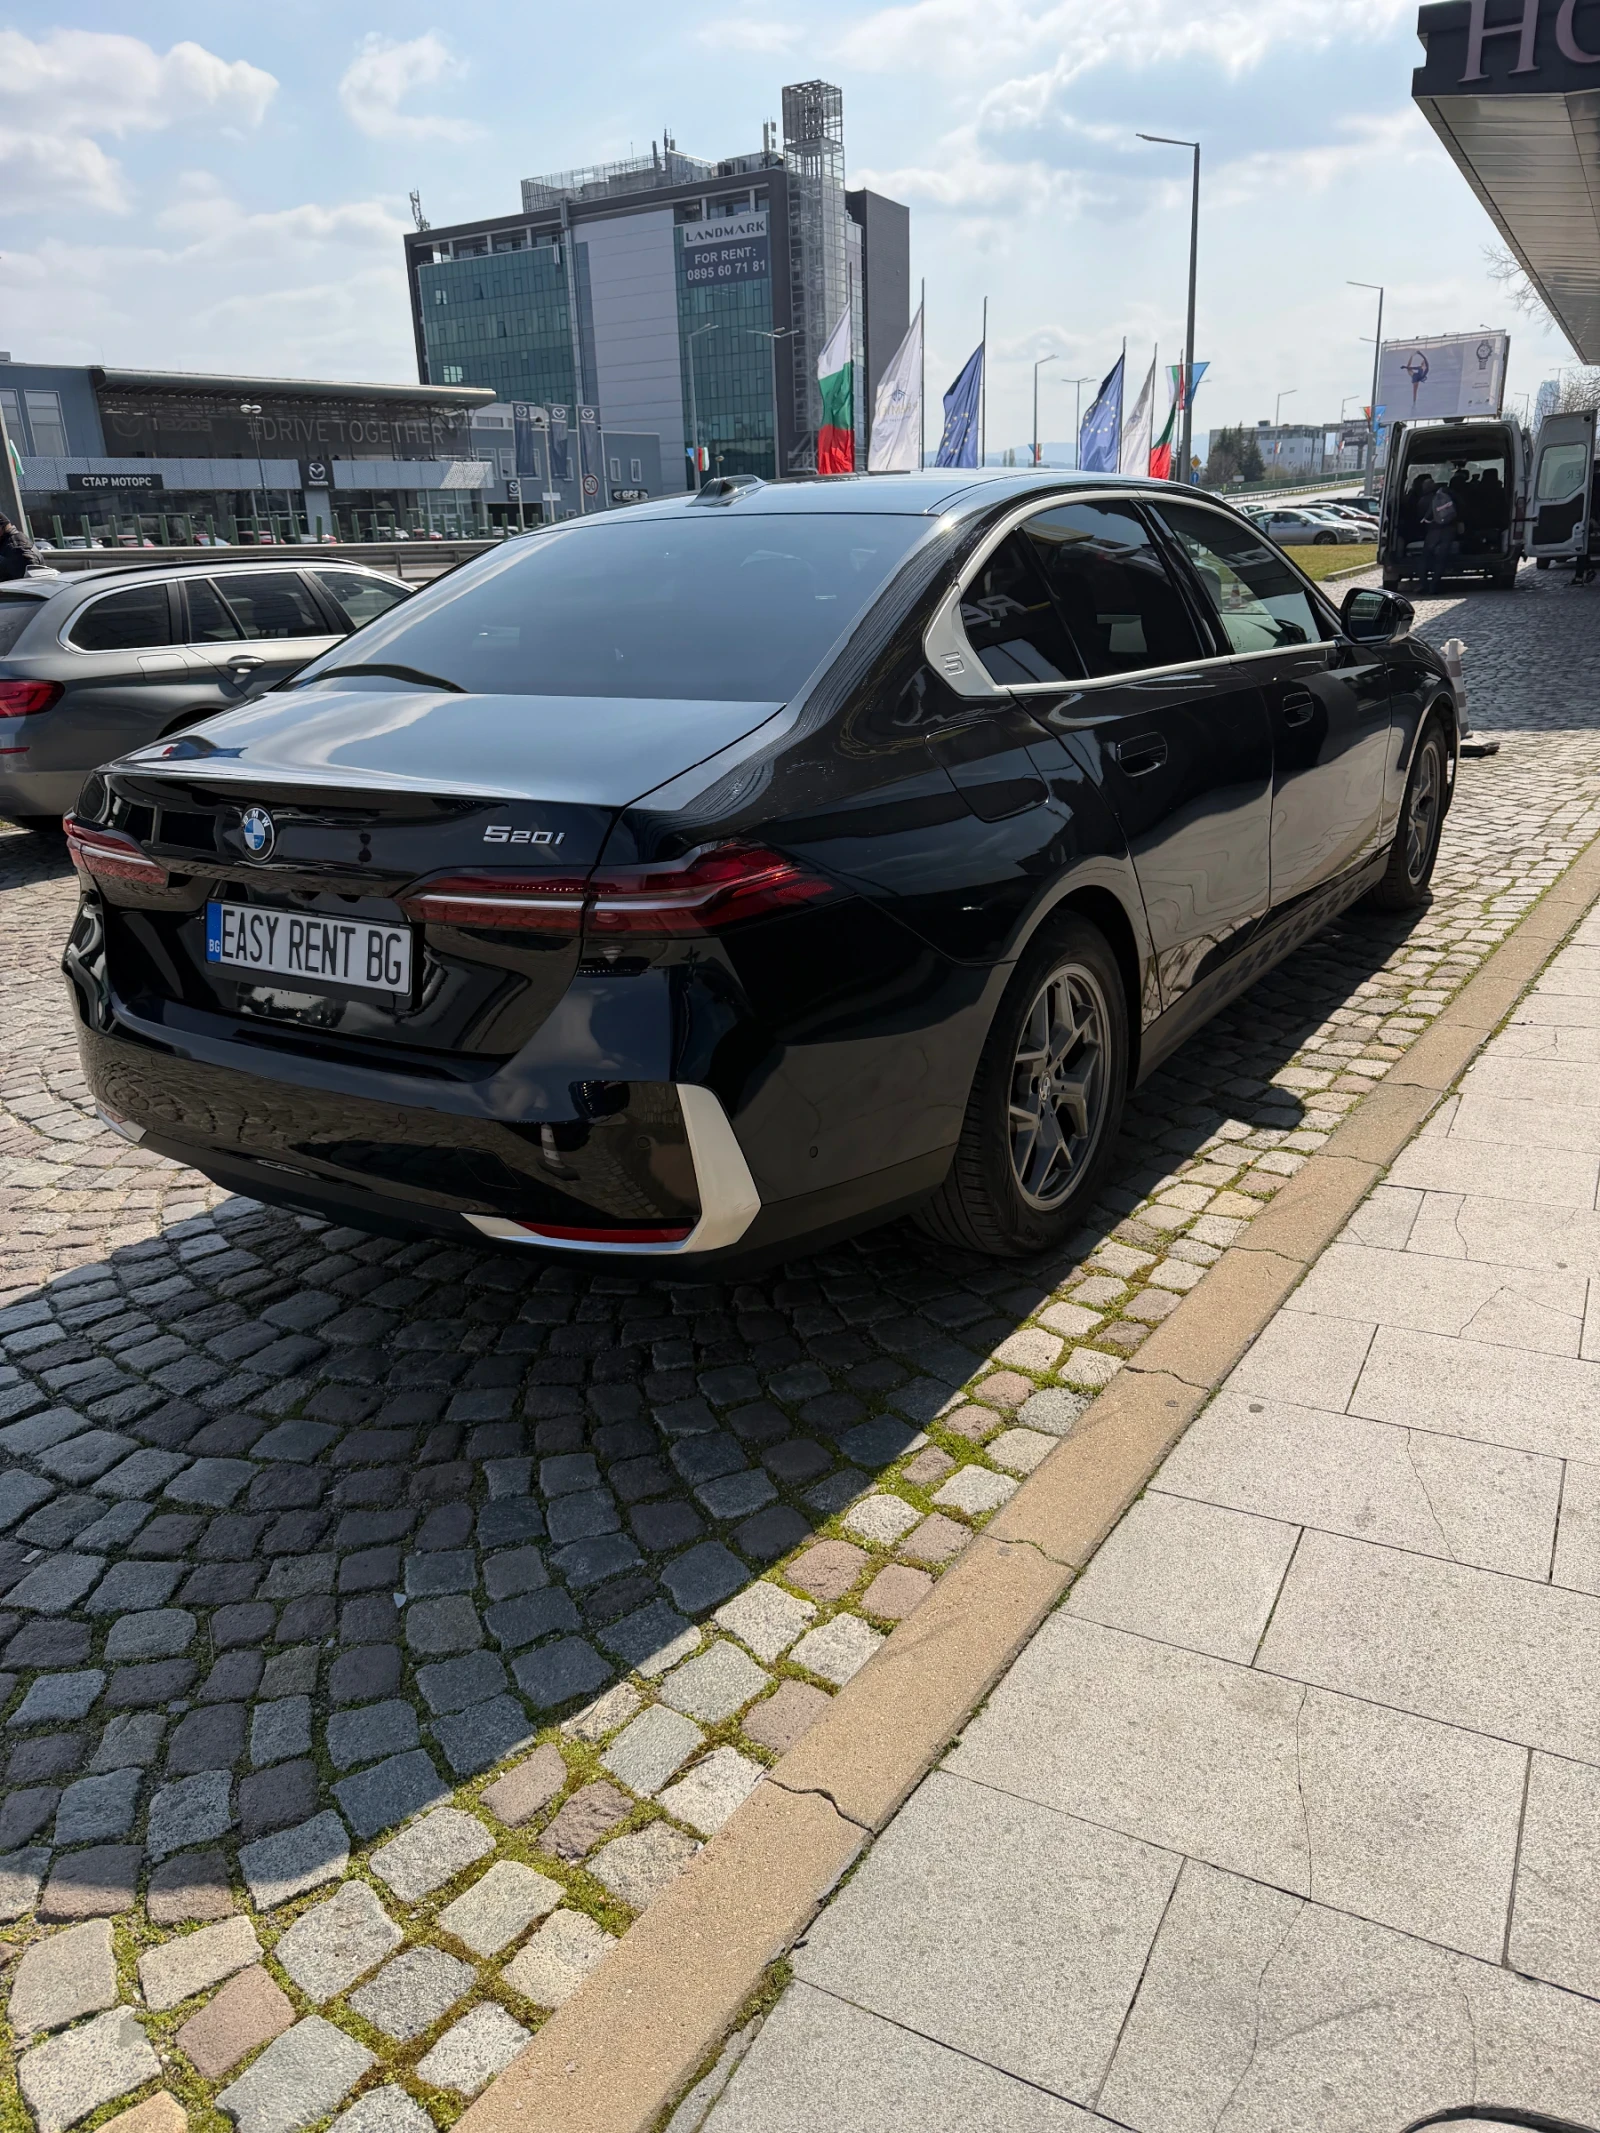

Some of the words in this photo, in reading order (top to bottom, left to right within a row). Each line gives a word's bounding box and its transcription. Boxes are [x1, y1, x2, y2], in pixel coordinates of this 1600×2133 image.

[685, 220, 765, 242] LANDMARK
[694, 252, 718, 264] FOR
[721, 246, 757, 261] RENT:
[687, 265, 715, 281] 0895
[717, 263, 732, 277] 60
[735, 261, 748, 274] 71
[752, 259, 766, 272] 81
[246, 416, 330, 442] #DRIVE
[338, 419, 444, 445] TOGETHER
[82, 476, 109, 487] СТАР
[111, 476, 152, 487] МОТОРС
[622, 490, 639, 498] GPS
[243, 810, 270, 828] BMW
[482, 825, 566, 846] 520i
[208, 938, 221, 953] BG
[222, 909, 279, 966] EASY
[288, 919, 357, 978] RENT
[366, 929, 402, 985] BG
